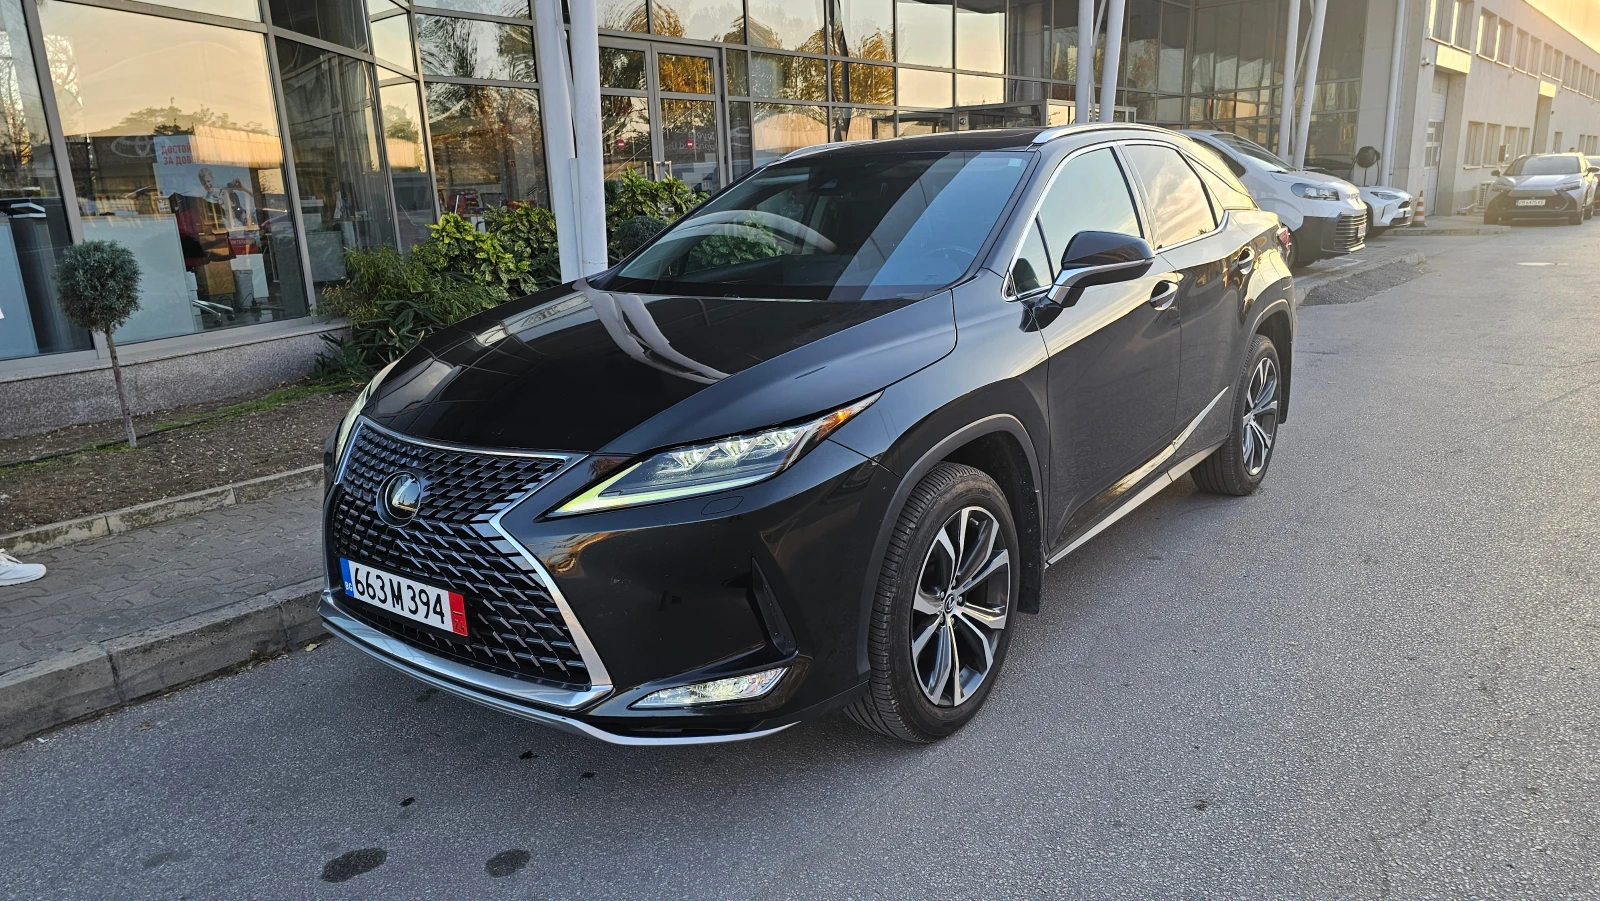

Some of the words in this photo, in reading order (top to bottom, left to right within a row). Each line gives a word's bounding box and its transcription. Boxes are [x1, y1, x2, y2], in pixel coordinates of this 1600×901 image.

[163, 157, 174, 166] ЗА
[344, 581, 353, 592] BG
[354, 567, 446, 625] 663M394
